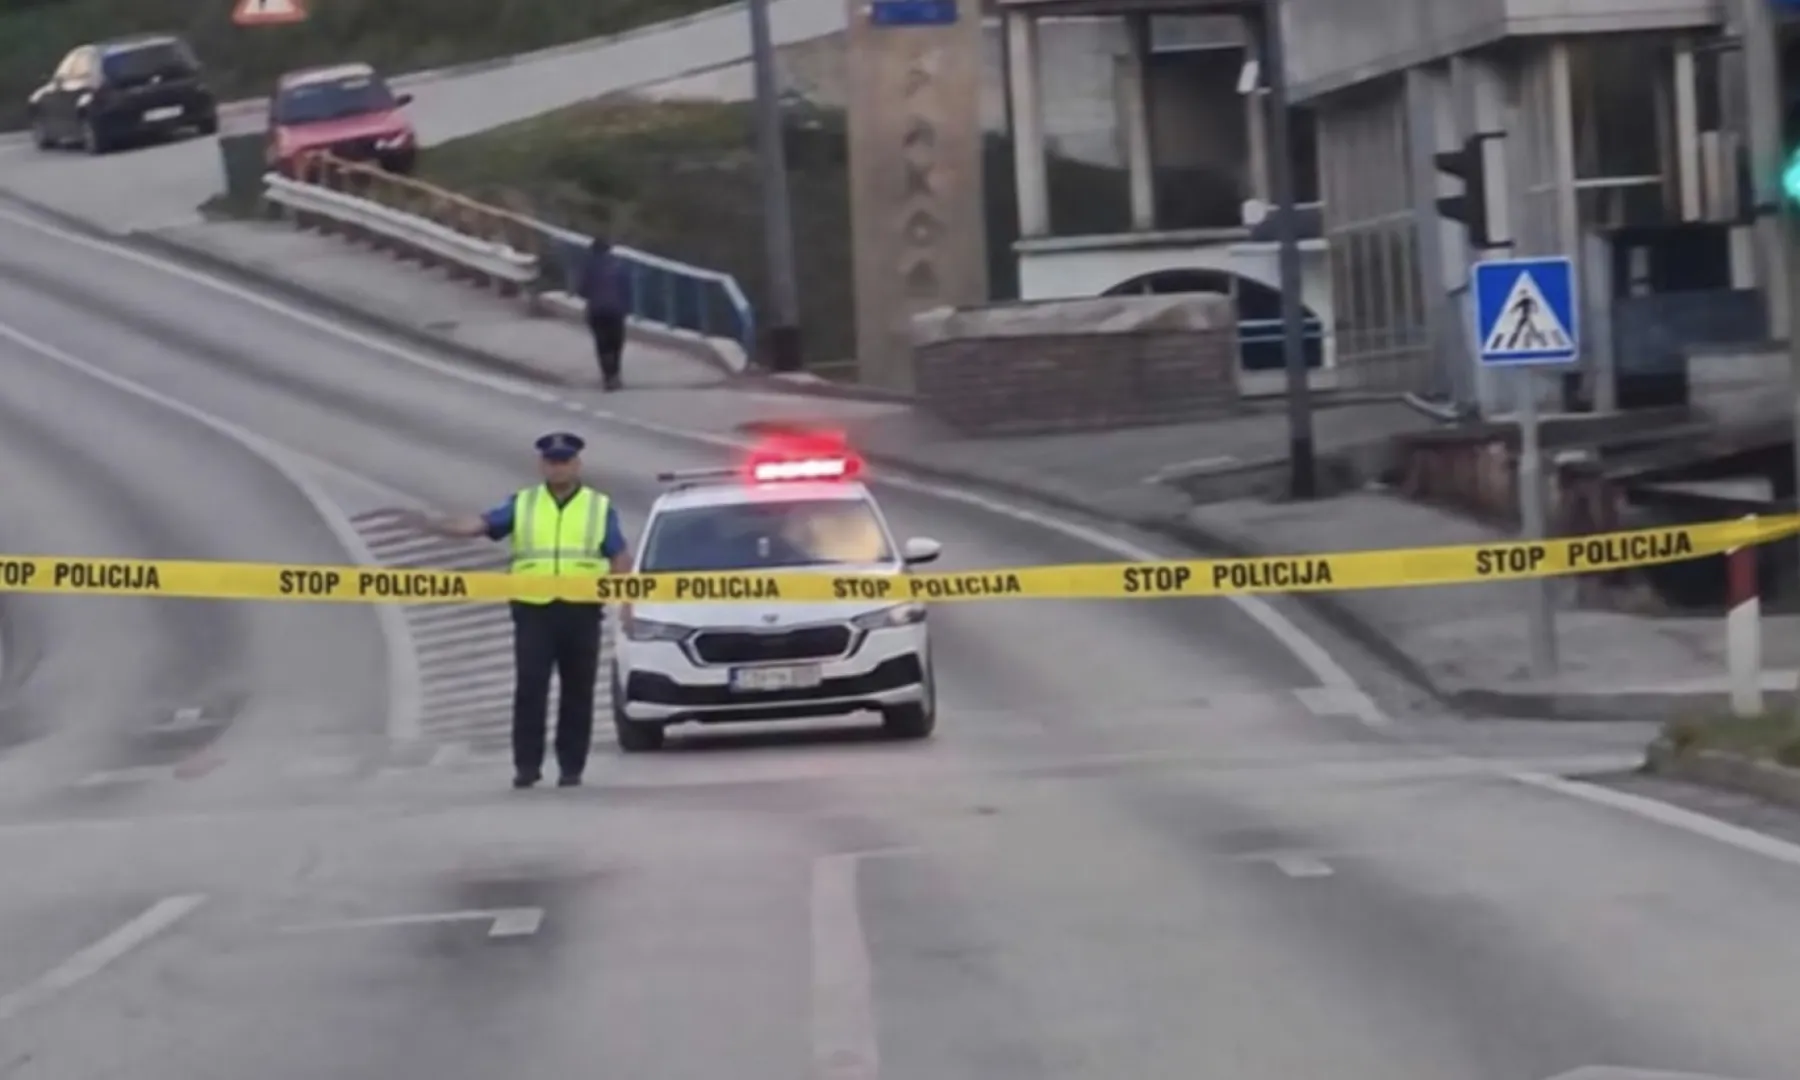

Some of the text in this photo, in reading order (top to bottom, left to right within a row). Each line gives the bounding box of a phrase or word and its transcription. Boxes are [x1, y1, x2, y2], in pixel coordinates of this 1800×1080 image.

[1476, 531, 1692, 576] STOP POLICIJA
[54, 562, 161, 589] POLICIJA
[279, 569, 468, 597] STOP POLICIJA
[596, 577, 780, 599] STOP POLICIJA
[832, 573, 1021, 599] STOP POLICIJA
[1123, 559, 1333, 593] STOP POLICIJA
